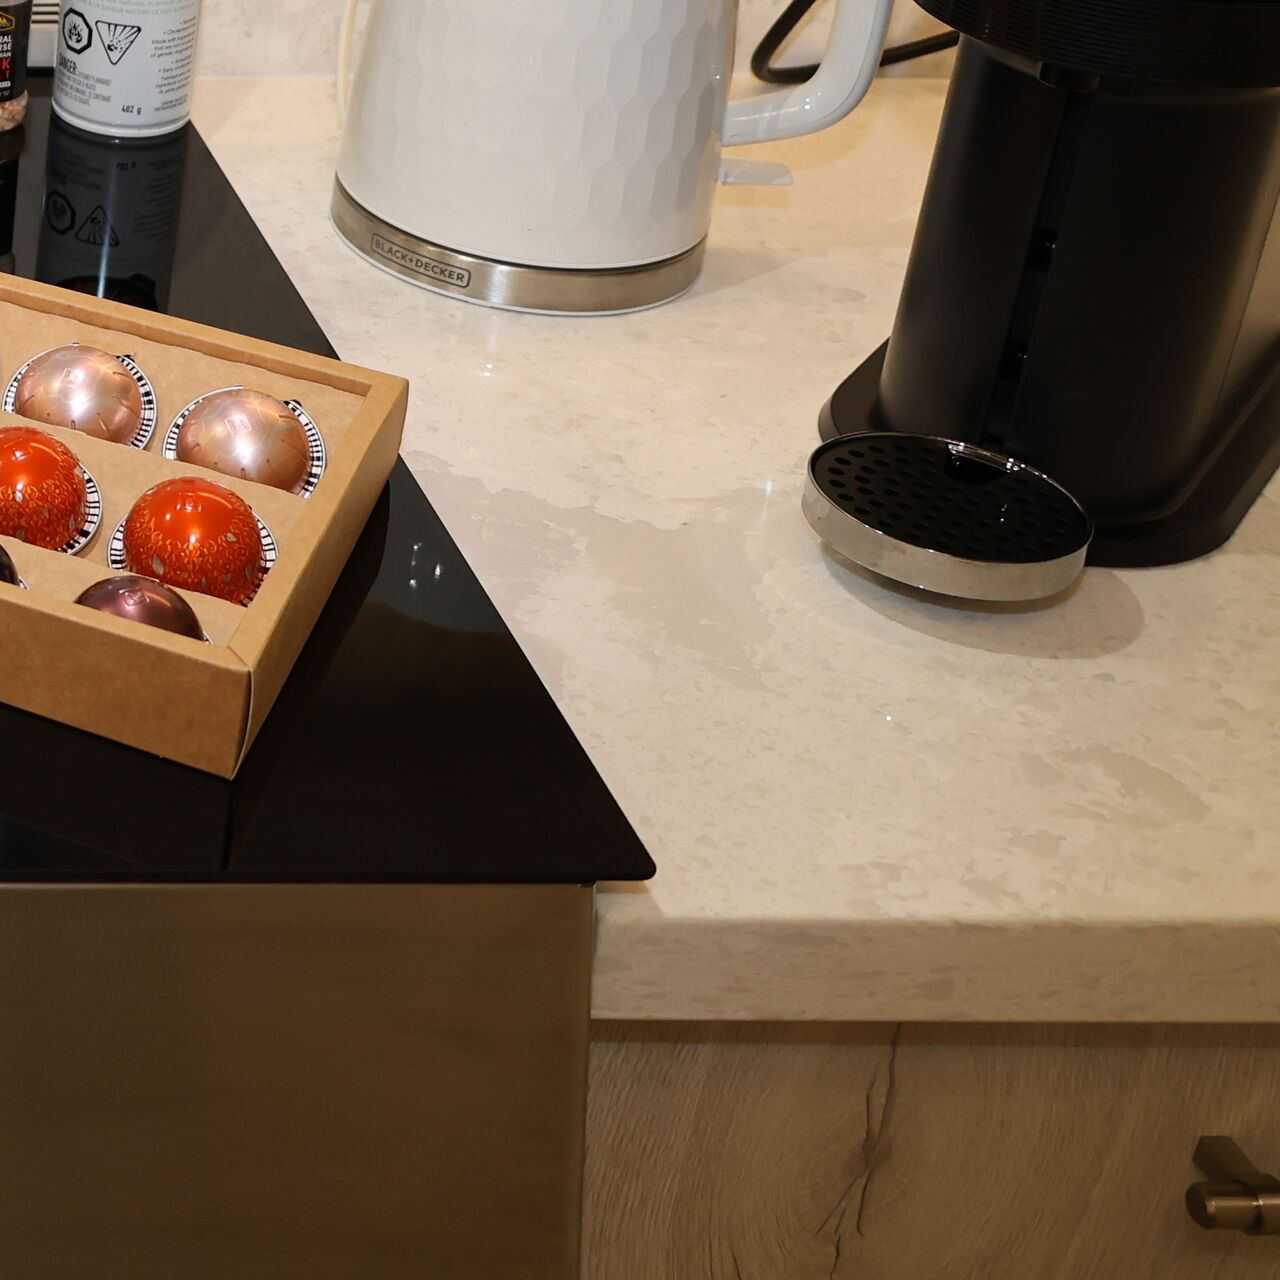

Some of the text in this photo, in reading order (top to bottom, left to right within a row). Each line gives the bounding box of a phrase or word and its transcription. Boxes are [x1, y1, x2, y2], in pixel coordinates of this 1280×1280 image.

[121, 105, 142, 116] 482 g
[375, 239, 465, 282] BLACK+DECKER
